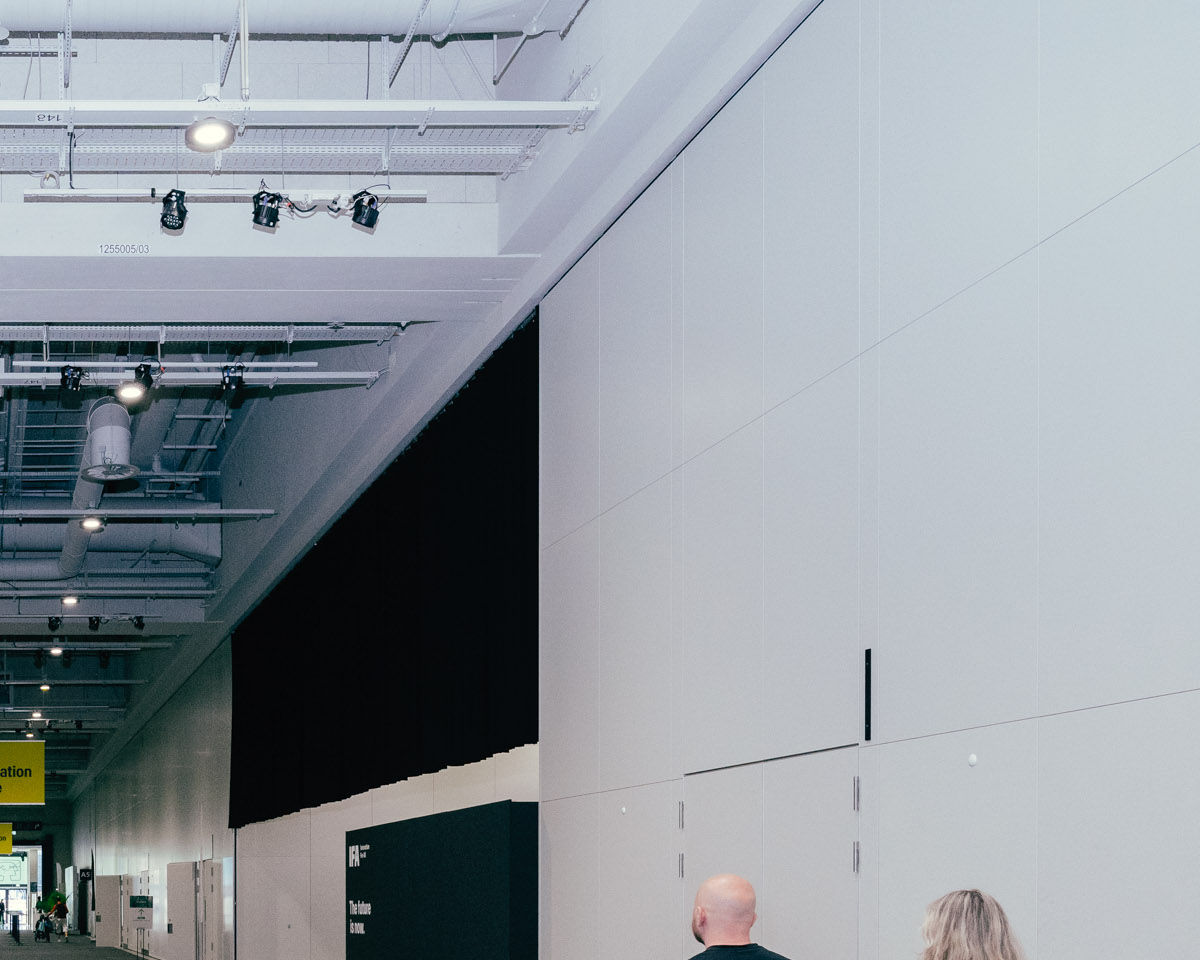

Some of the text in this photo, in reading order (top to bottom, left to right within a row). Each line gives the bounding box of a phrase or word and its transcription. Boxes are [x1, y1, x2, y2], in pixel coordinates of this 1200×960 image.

[99, 244, 150, 254] 1255005/03
[349, 845, 360, 868] IFA
[349, 900, 358, 915] The
